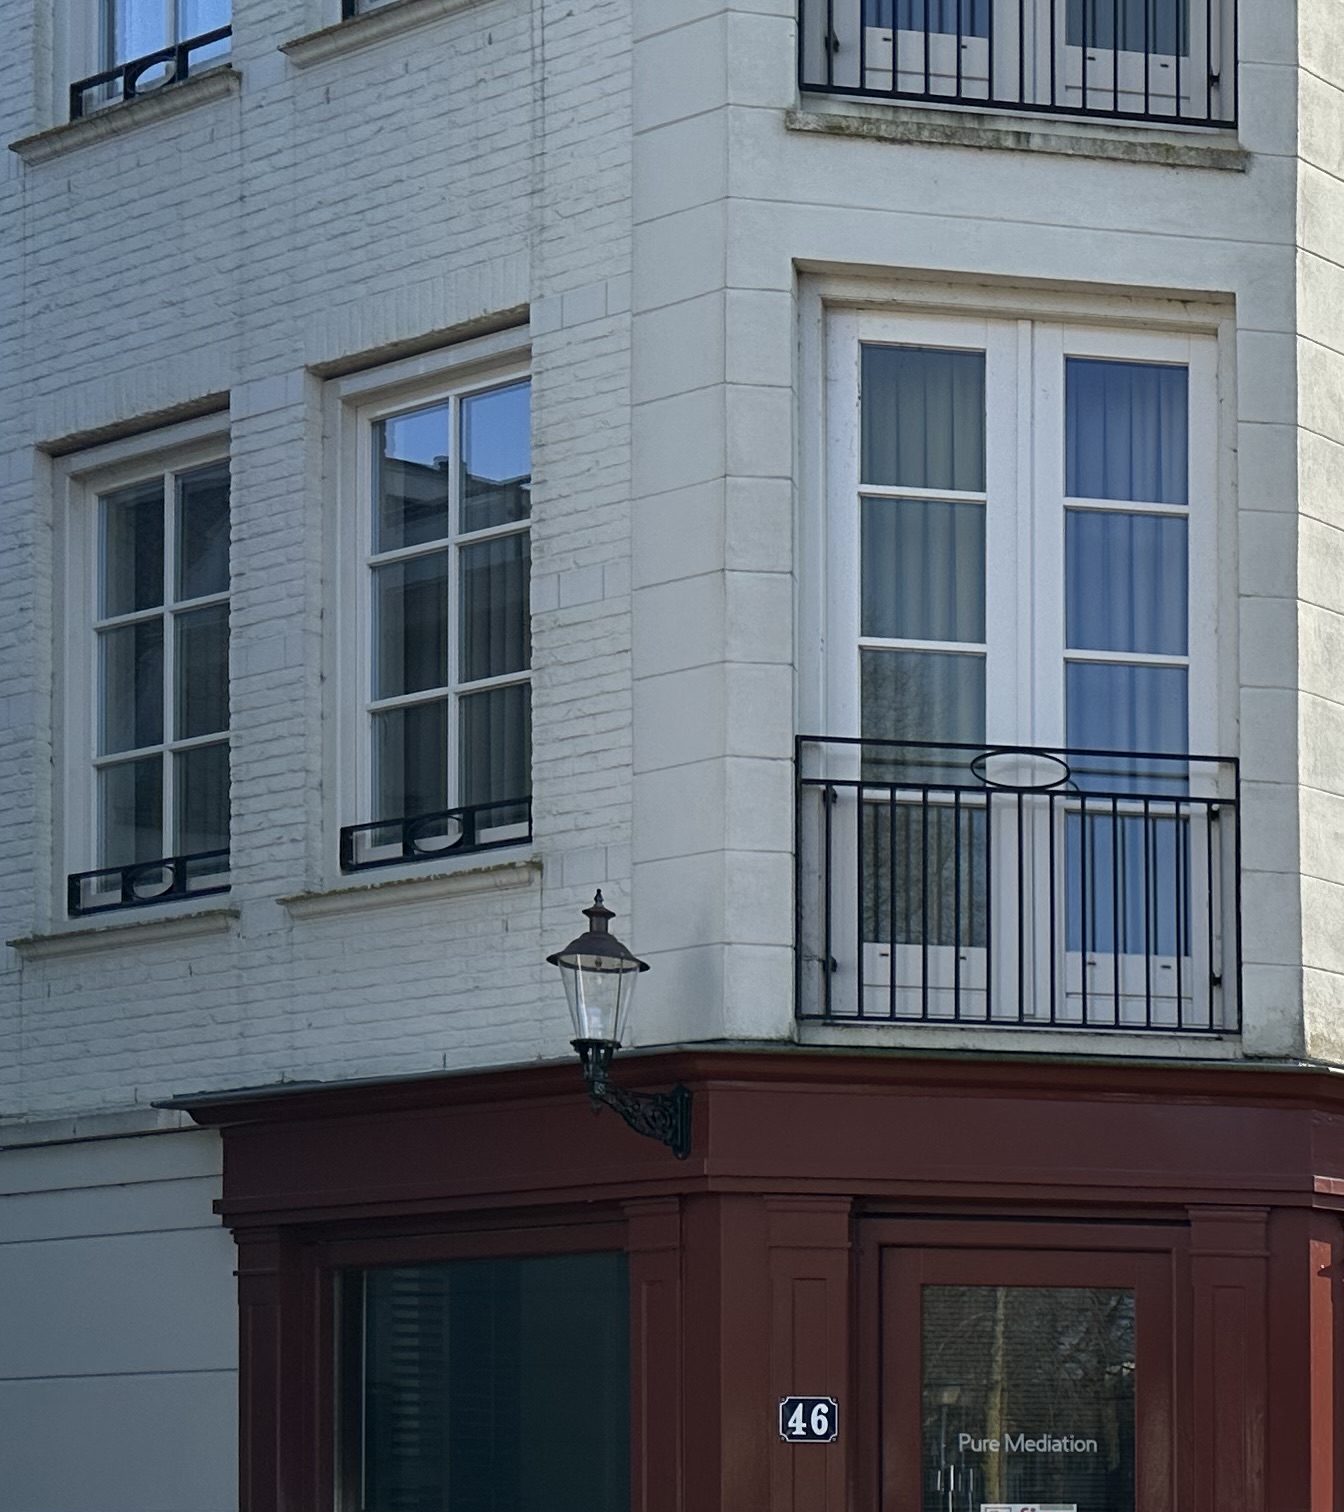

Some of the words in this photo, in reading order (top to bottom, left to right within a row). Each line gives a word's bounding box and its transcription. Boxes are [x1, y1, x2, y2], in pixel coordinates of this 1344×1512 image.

[788, 1402, 829, 1436] 46
[959, 1433, 1000, 1453] Pure
[1004, 1433, 1098, 1453] Mediation
